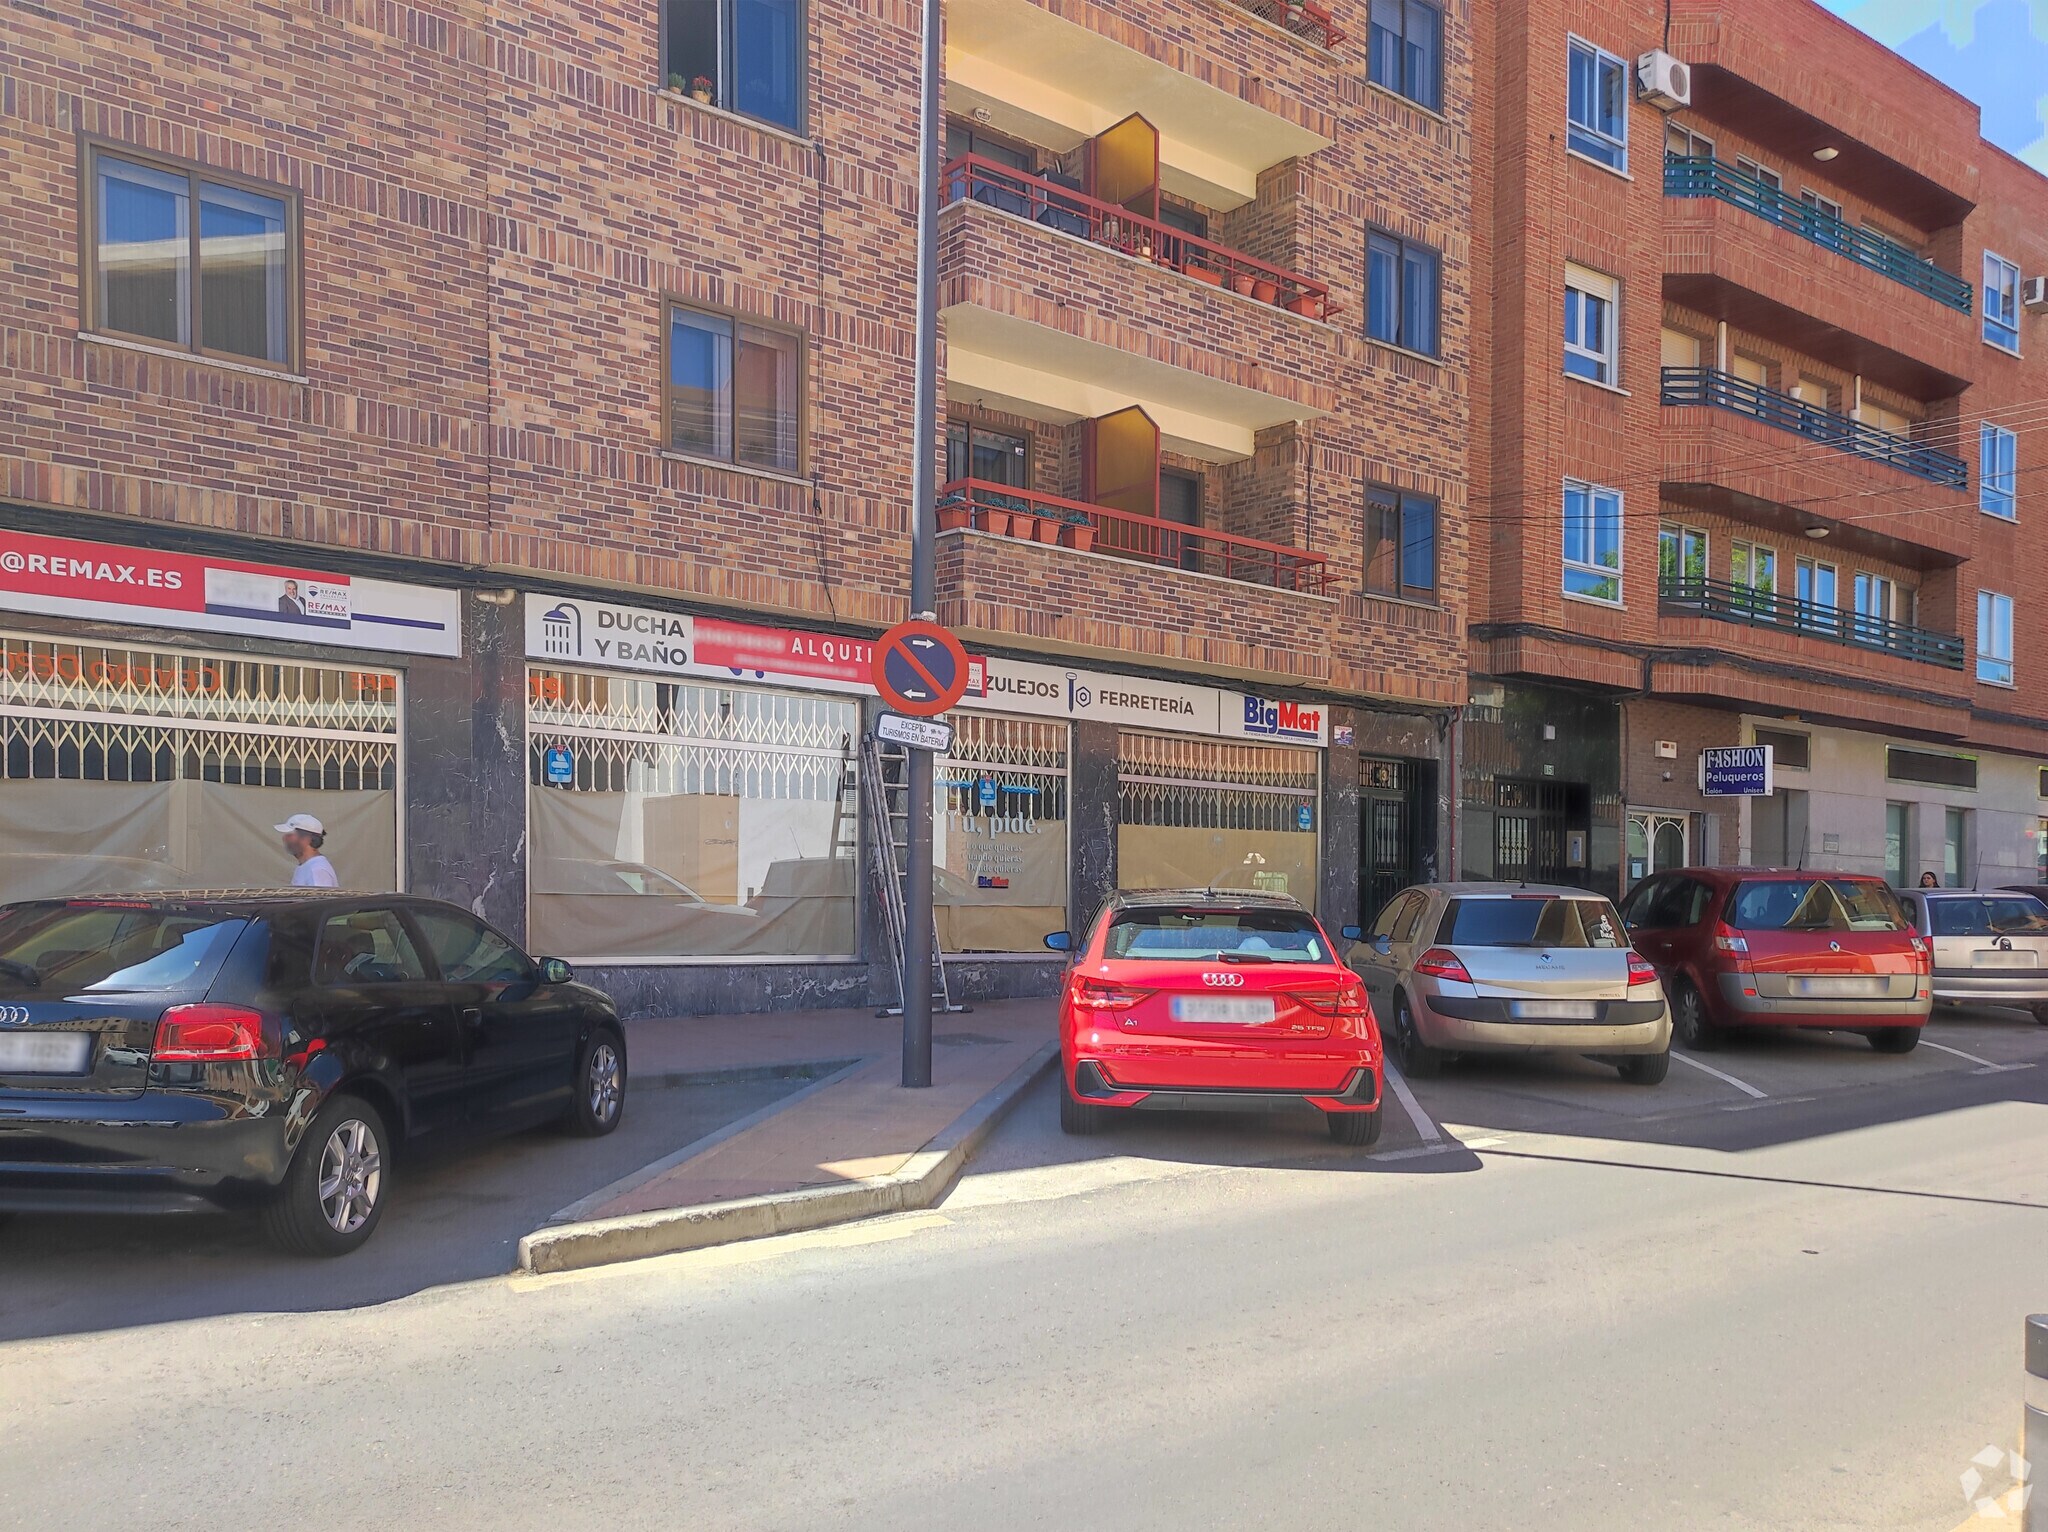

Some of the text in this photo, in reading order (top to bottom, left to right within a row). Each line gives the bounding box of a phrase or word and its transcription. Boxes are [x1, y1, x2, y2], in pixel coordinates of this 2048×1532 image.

[0, 551, 182, 590] @REMAX.ES
[308, 601, 347, 613] RE/MAX
[598, 610, 685, 638] DUCHA
[594, 638, 611, 657] Y
[617, 640, 687, 666] BAÑO
[1099, 690, 1195, 715] FERRETERÍA
[1244, 696, 1320, 734] BigMat
[882, 726, 910, 741] TURISMOS
[1706, 748, 1764, 769] FASHION
[1706, 771, 1764, 784] Peluqueros
[1743, 786, 1764, 794] Unisex
[989, 811, 1042, 840] pide.
[1124, 1018, 1138, 1026] A1
